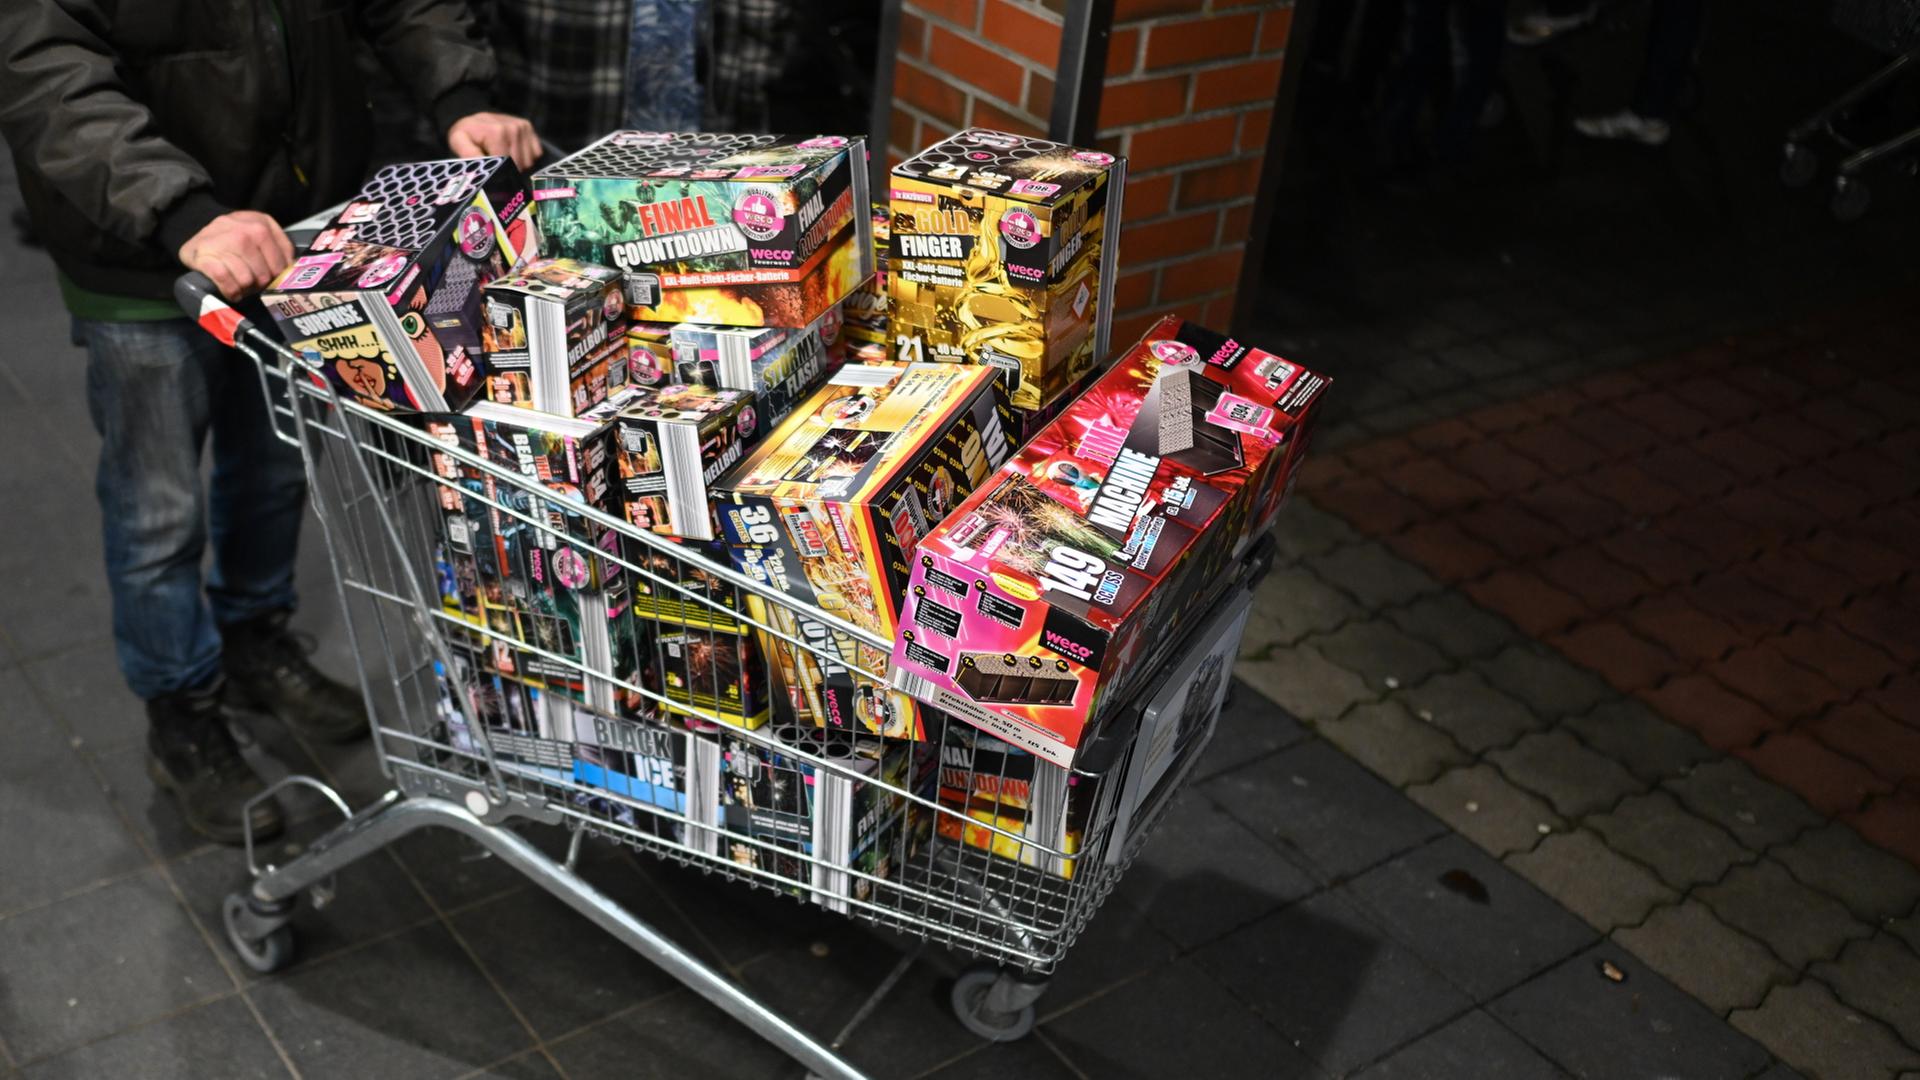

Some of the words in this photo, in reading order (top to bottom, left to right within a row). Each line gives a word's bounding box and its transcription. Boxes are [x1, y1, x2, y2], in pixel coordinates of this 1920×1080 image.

[499, 190, 525, 220] weco
[637, 194, 716, 237] FINAL
[797, 190, 825, 233] FINAL
[915, 208, 970, 235] GOLD
[611, 228, 736, 268] COUNTDOWN
[750, 248, 793, 260] weco
[900, 235, 963, 258] FINGER
[1007, 262, 1045, 278] weco
[277, 294, 303, 319] BIG
[293, 303, 364, 337] SURPRISE
[568, 321, 608, 367] HELLBOY
[762, 330, 816, 392] STORMY
[896, 334, 924, 362] 21
[1208, 338, 1240, 365] weco
[786, 354, 819, 398] FLASH
[1074, 419, 1130, 468] TIME
[535, 454, 553, 481] THE
[704, 438, 743, 485] HELLBOY
[1089, 447, 1161, 532] MACHINE
[728, 509, 751, 543] SCHUSS
[740, 505, 779, 543] 36
[799, 520, 823, 550] 500
[1037, 546, 1107, 601] 149
[1094, 570, 1124, 605] SCHUSS
[1045, 629, 1092, 659] weco
[826, 689, 842, 726] weco
[593, 717, 672, 759] BLACK
[634, 754, 676, 789] ICE
[943, 745, 972, 768] NAL
[942, 767, 1029, 799] UNTDOWN
